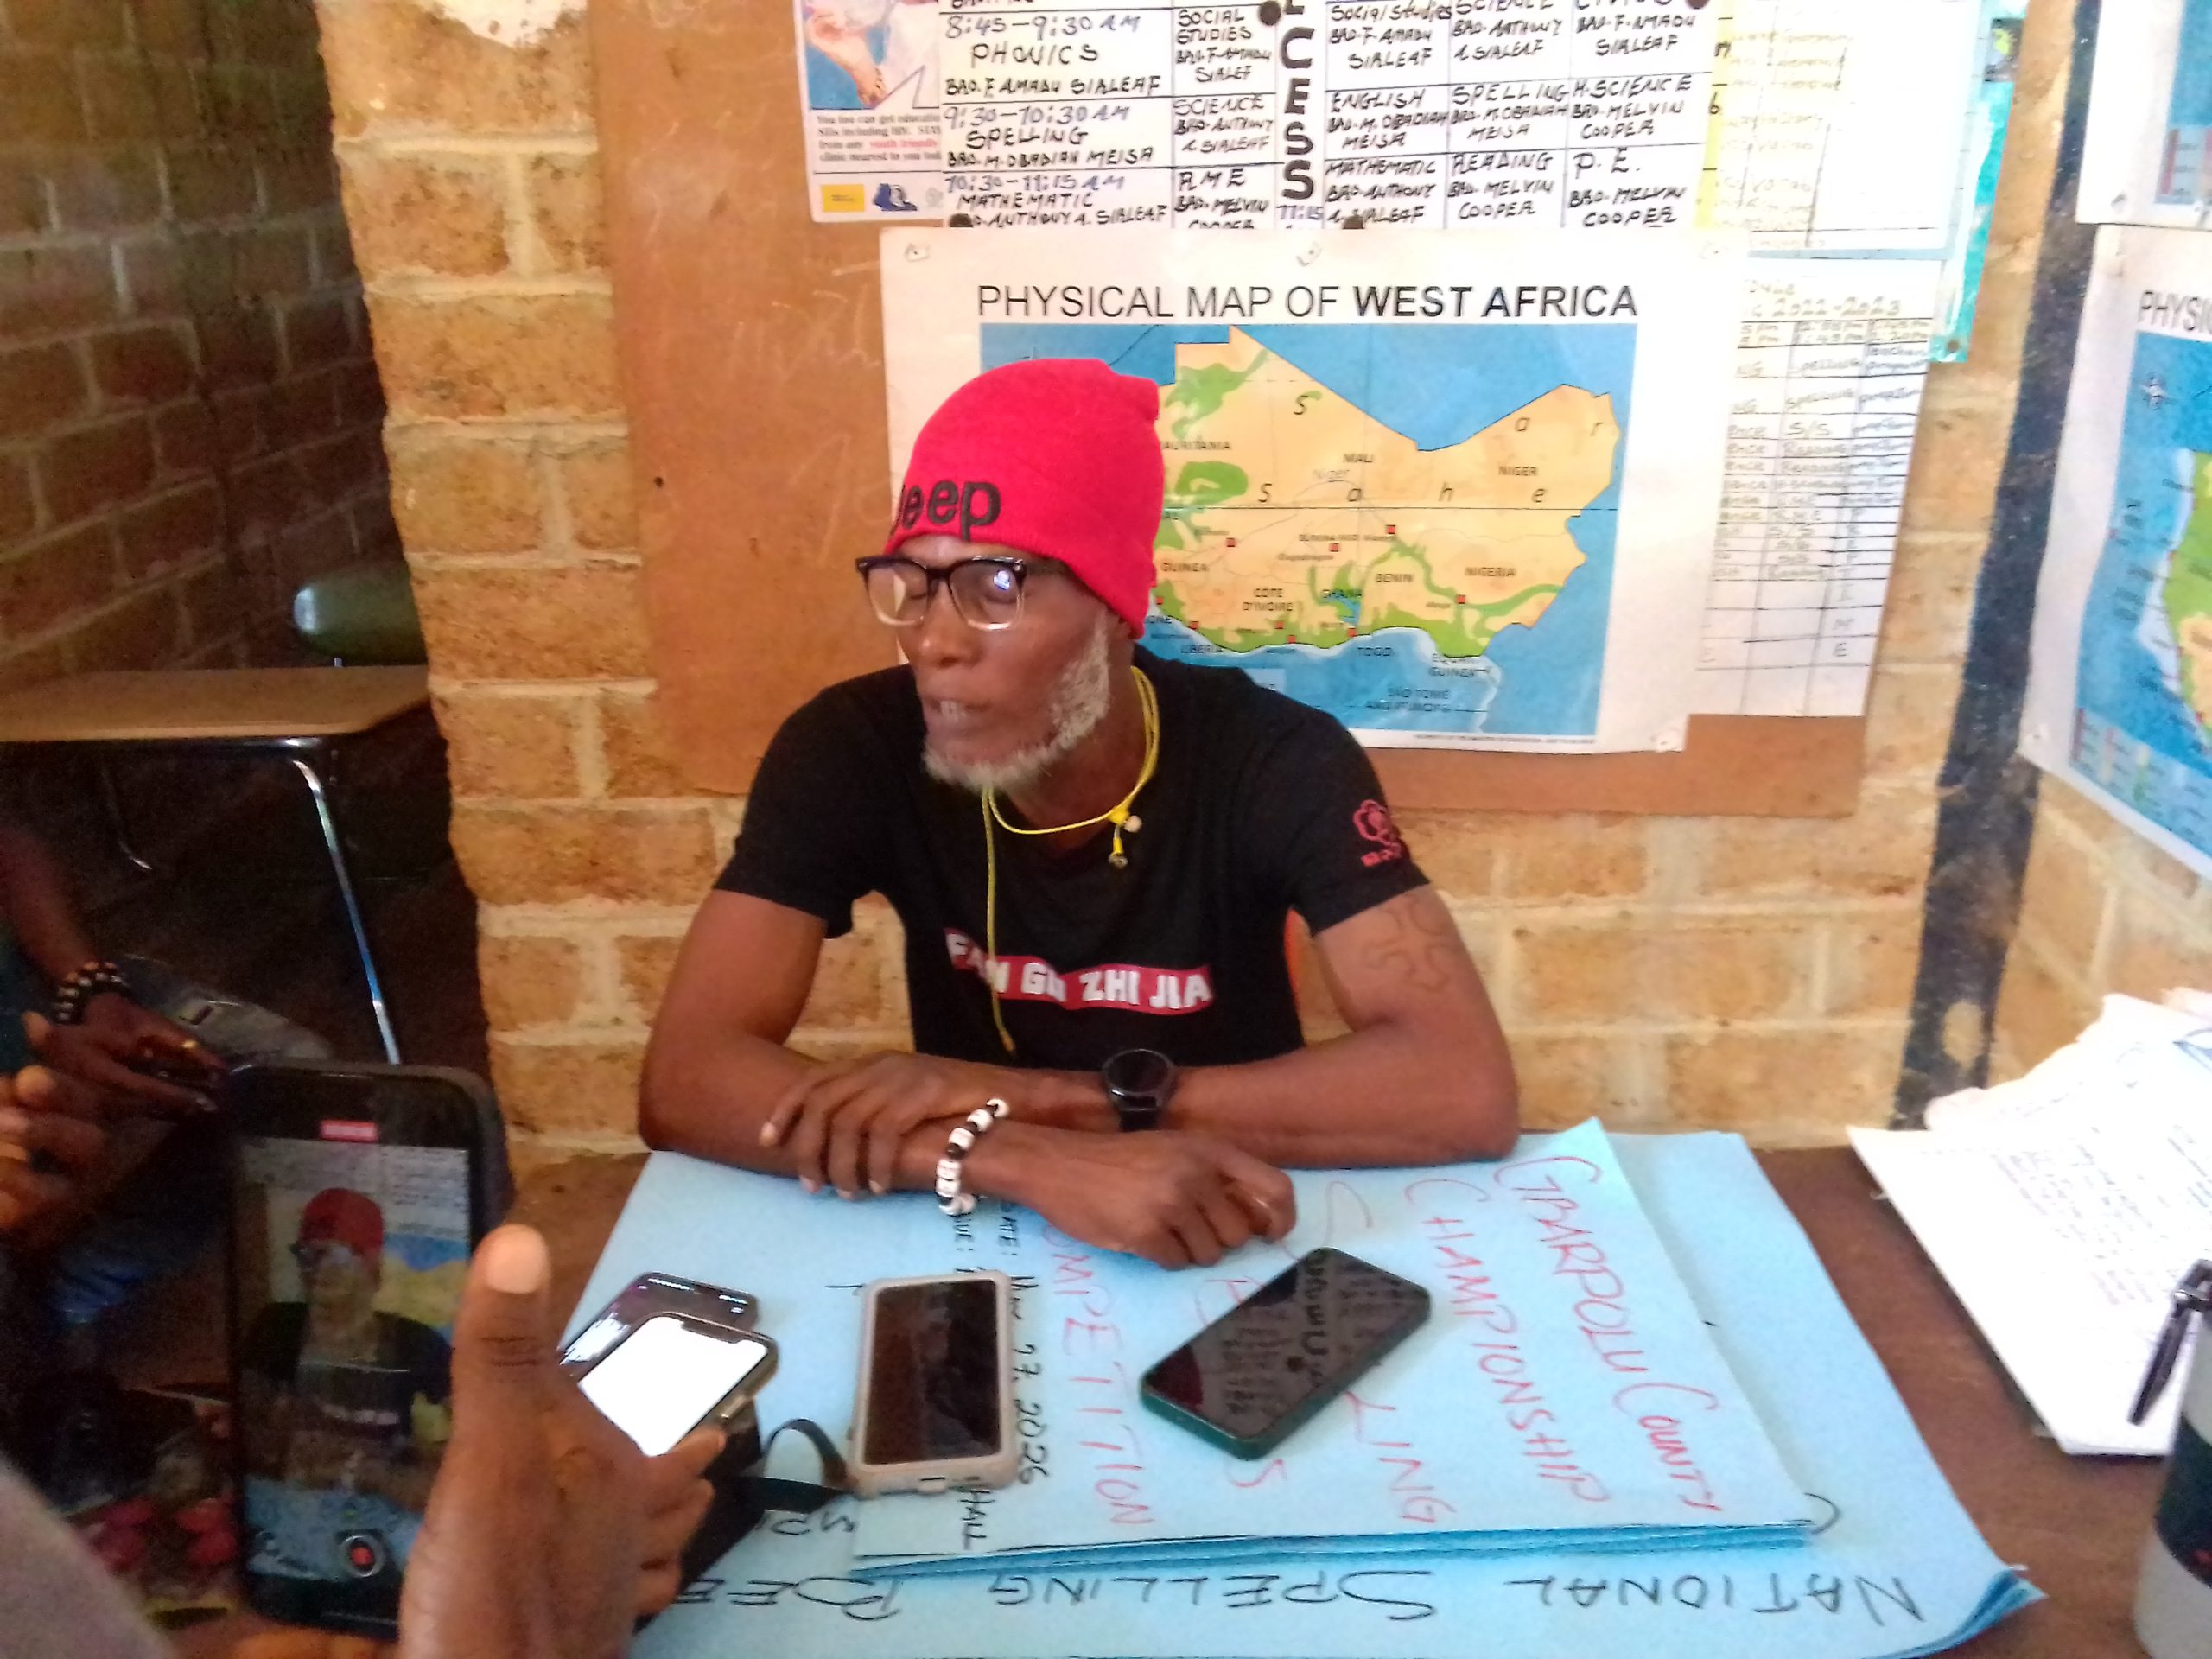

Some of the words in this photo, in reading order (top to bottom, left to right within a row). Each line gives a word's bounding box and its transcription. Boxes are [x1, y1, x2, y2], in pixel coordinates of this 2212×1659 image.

[1178, 8, 1244, 27] SOCIAL
[1177, 26, 1252, 44] STUDIES
[1331, 88, 1426, 112] ENGLISH
[1452, 84, 1569, 105] SPELLING
[966, 127, 1089, 149] SPELLING
[978, 286, 1173, 317] PHYSICAL
[1187, 286, 1272, 317] MAP
[1285, 286, 1338, 317] OF
[1354, 286, 1471, 317] WEST
[1481, 286, 1638, 317] AFRICA
[1160, 441, 1232, 450] AURITANIA
[1498, 466, 1538, 476] NIGER
[895, 480, 1001, 542] eep
[1162, 562, 1207, 572] GUINEA
[1376, 573, 1414, 583] BENIN
[1465, 567, 1516, 577] NIGERIA
[1079, 969, 1140, 1005] ZHI
[1149, 973, 1211, 1010] JIA
[1042, 1222, 1156, 1525] OMPETITION
[1014, 1398, 1049, 1484] 2026
[988, 1570, 1436, 1620] SPELLING
[1504, 1573, 1925, 1625] NATIONAL
